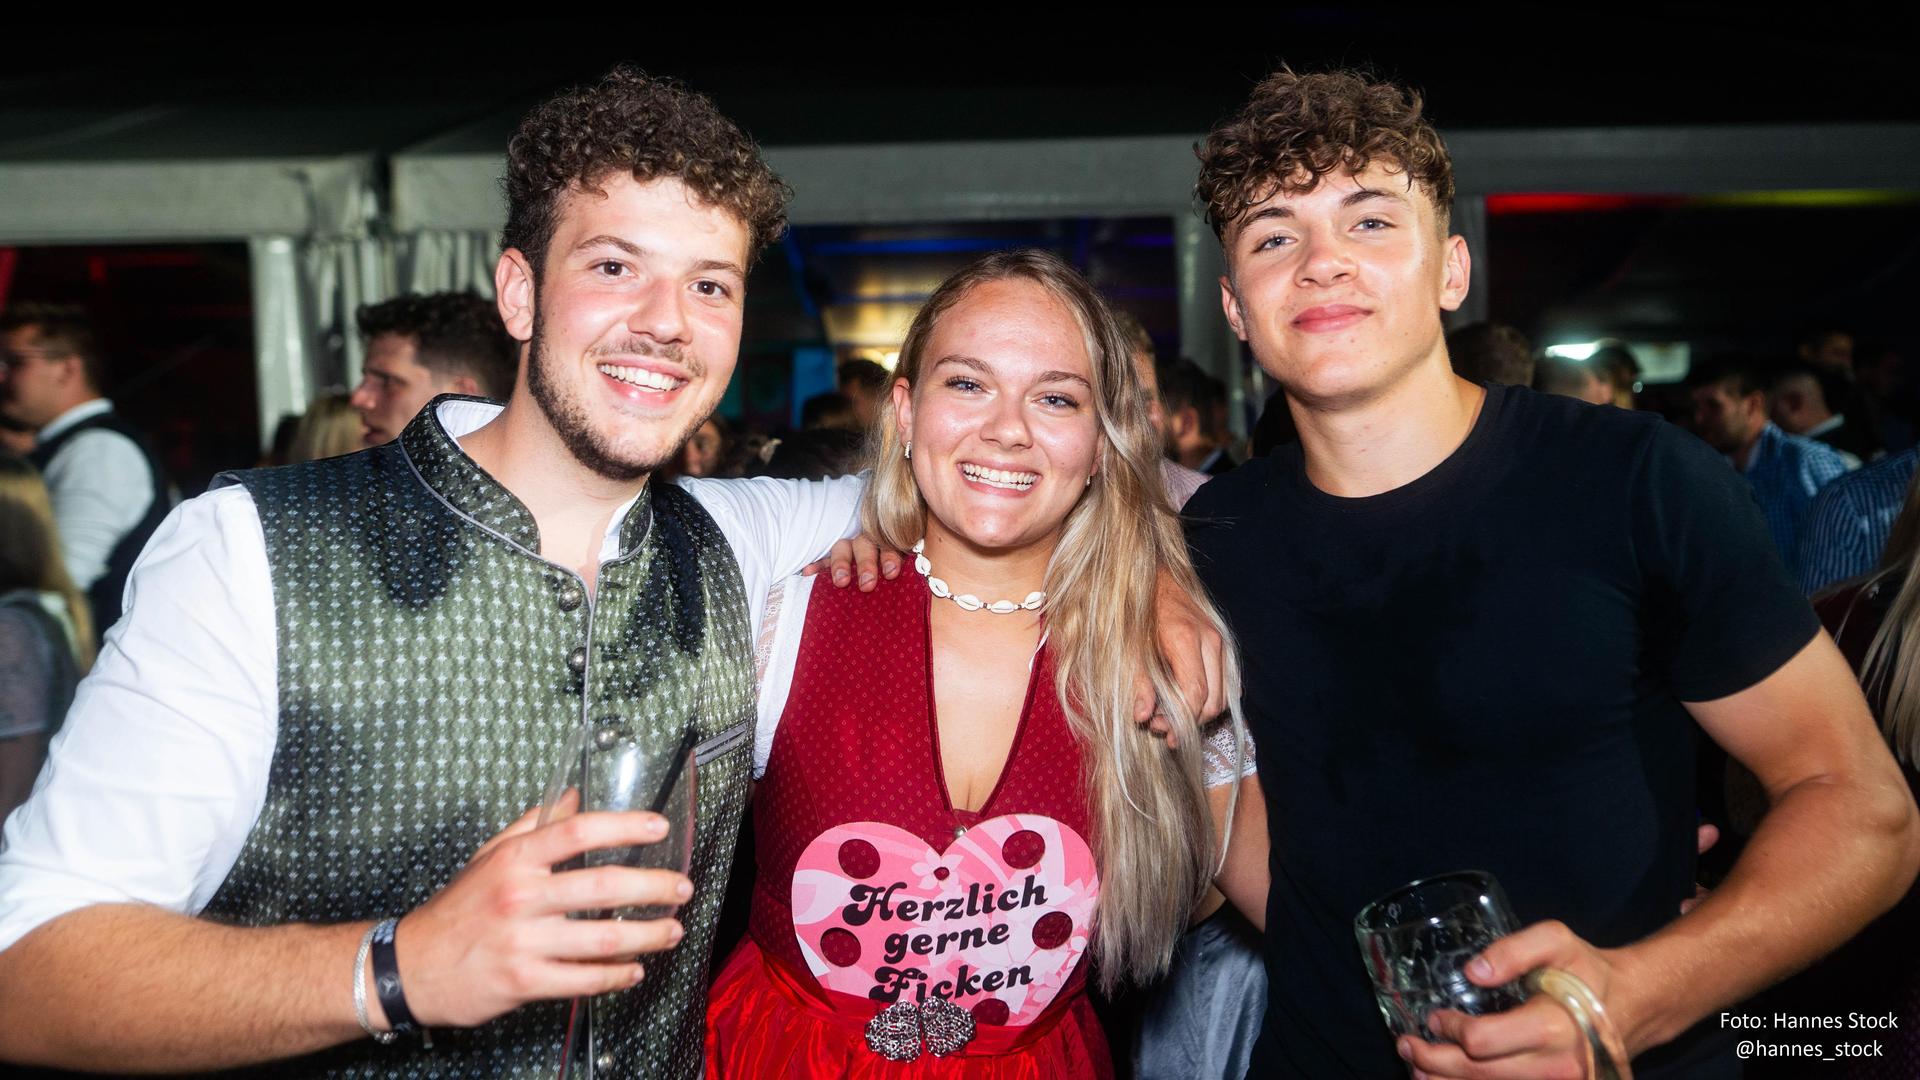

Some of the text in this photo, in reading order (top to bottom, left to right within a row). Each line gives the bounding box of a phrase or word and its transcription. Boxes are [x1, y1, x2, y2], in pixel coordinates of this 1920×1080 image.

[842, 875, 1048, 926] Herzlich
[883, 923, 1010, 964] gerne
[868, 964, 1033, 1002] Ficken
